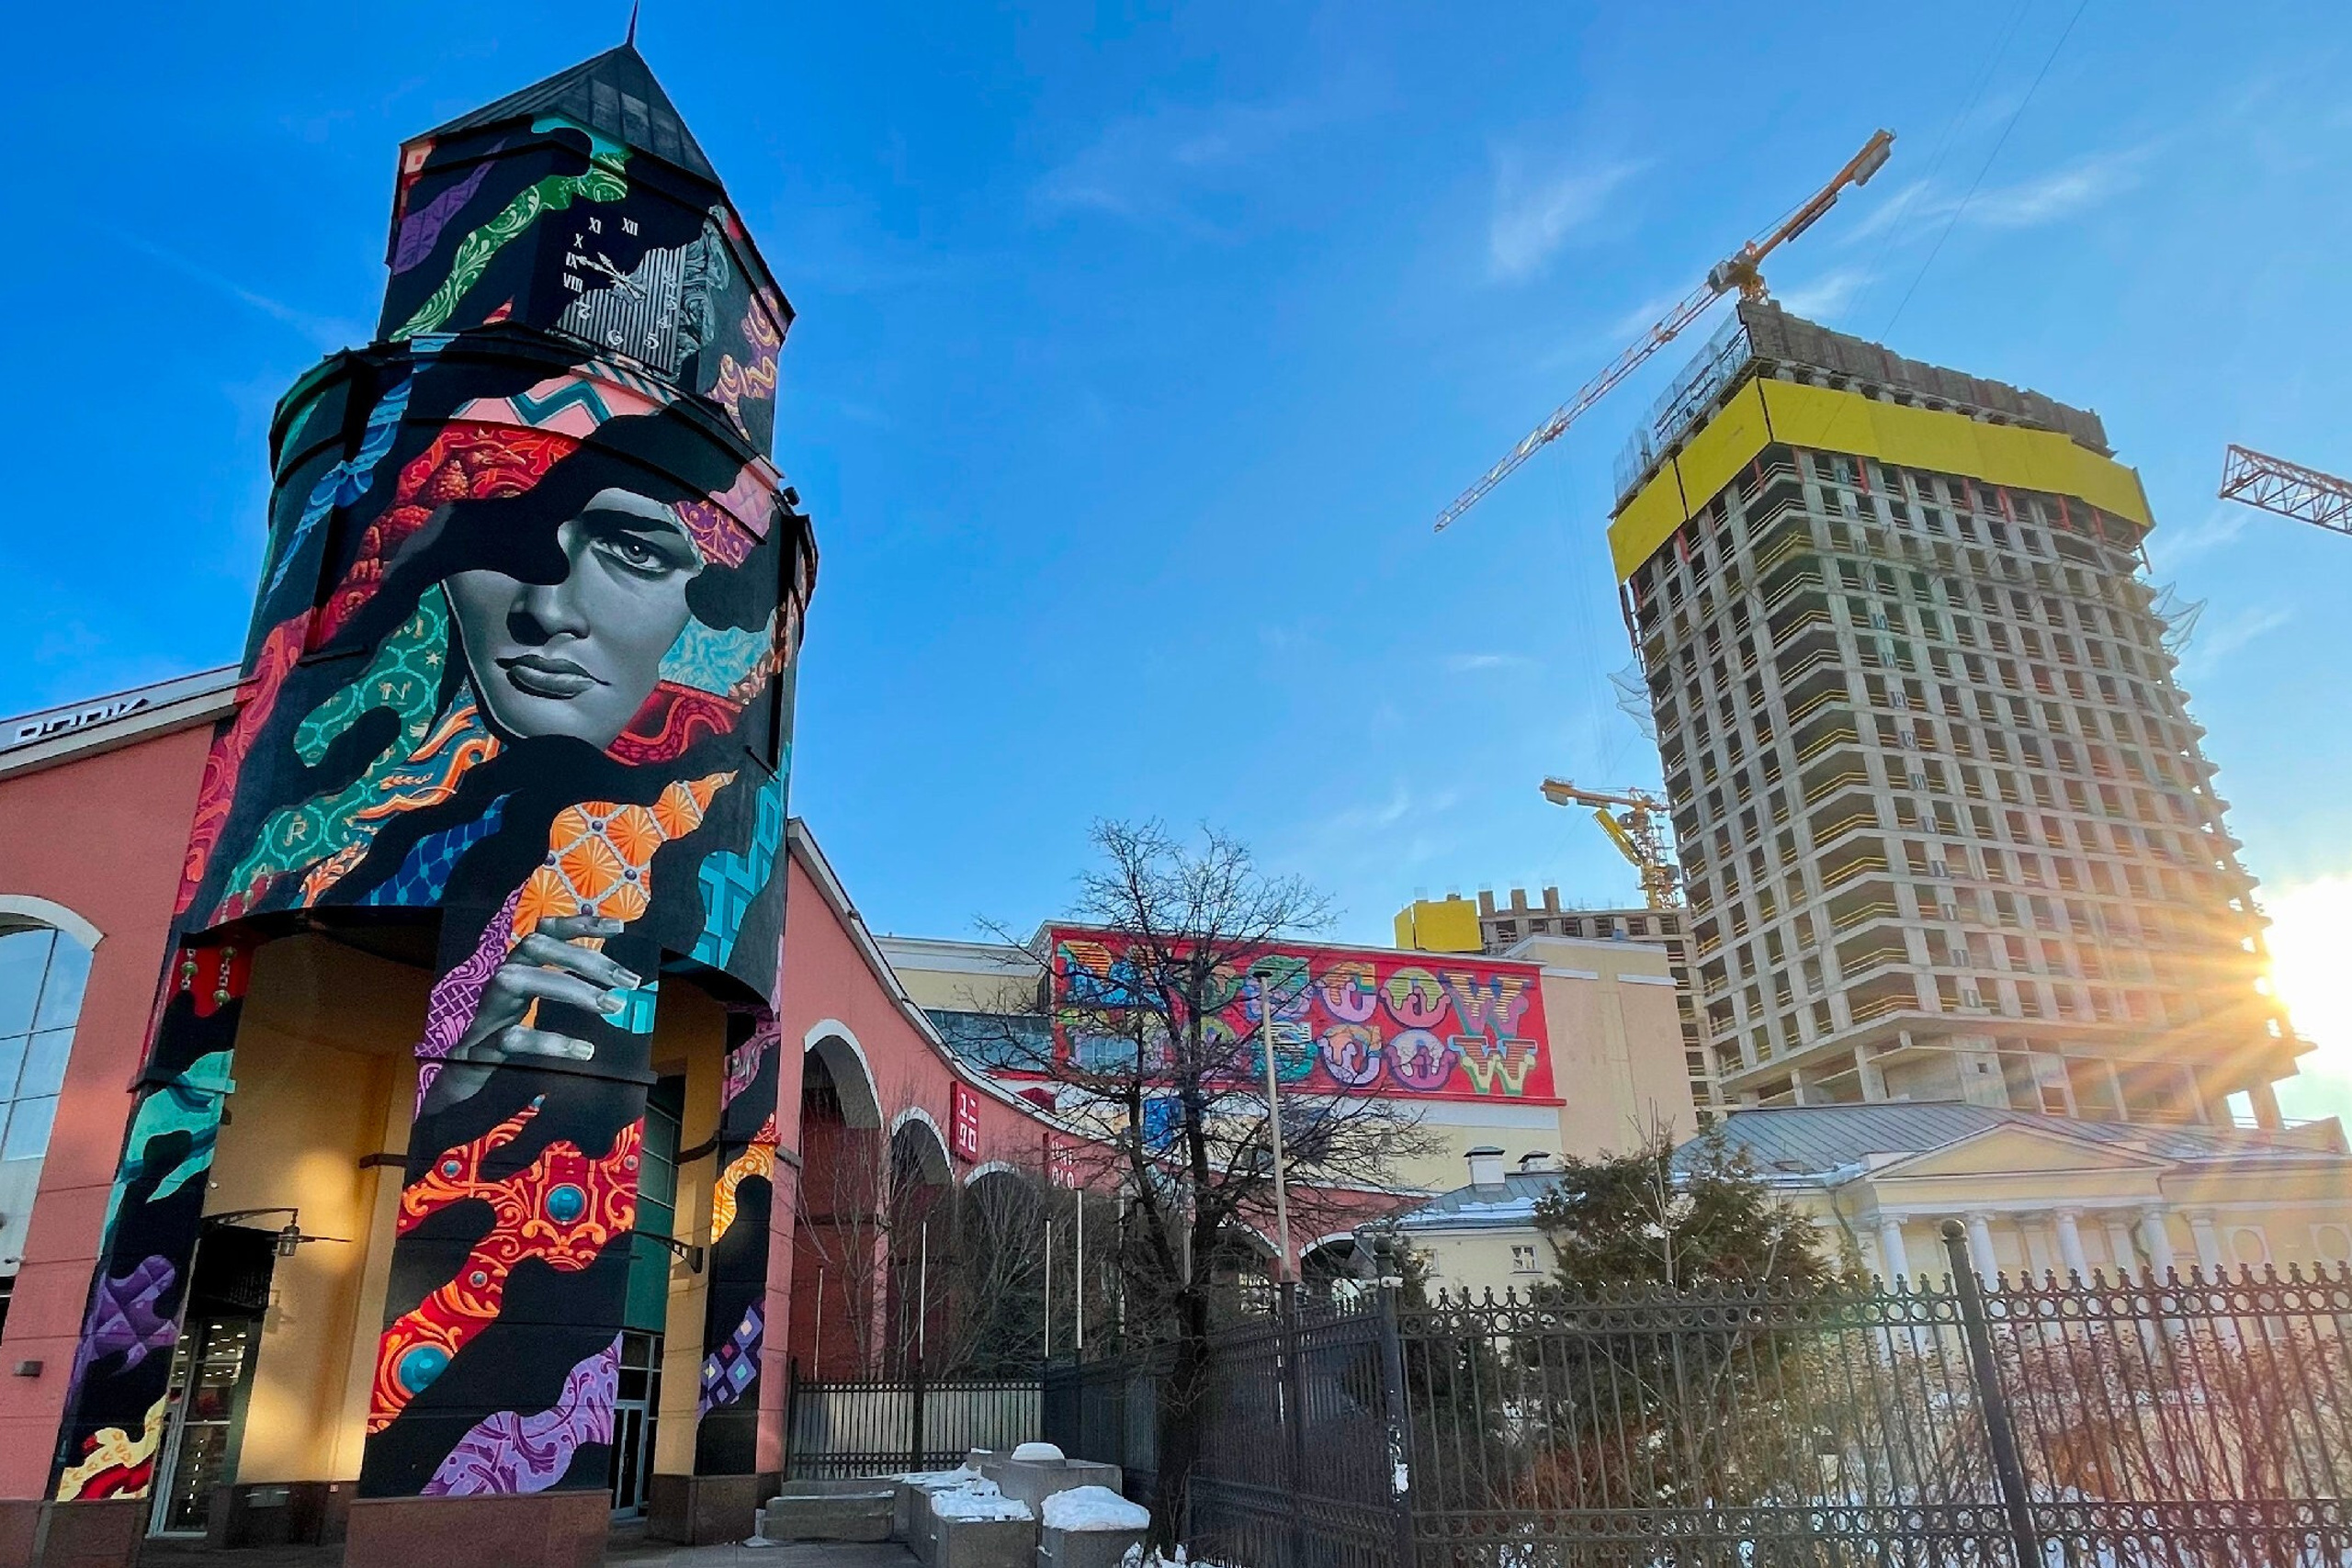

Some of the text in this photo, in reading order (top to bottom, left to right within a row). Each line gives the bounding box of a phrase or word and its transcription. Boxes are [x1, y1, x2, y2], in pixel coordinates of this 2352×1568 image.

[588, 217, 602, 234] XI
[621, 217, 638, 236] XII
[573, 232, 583, 249] X
[562, 272, 583, 293] VIII
[643, 331, 660, 349] 5
